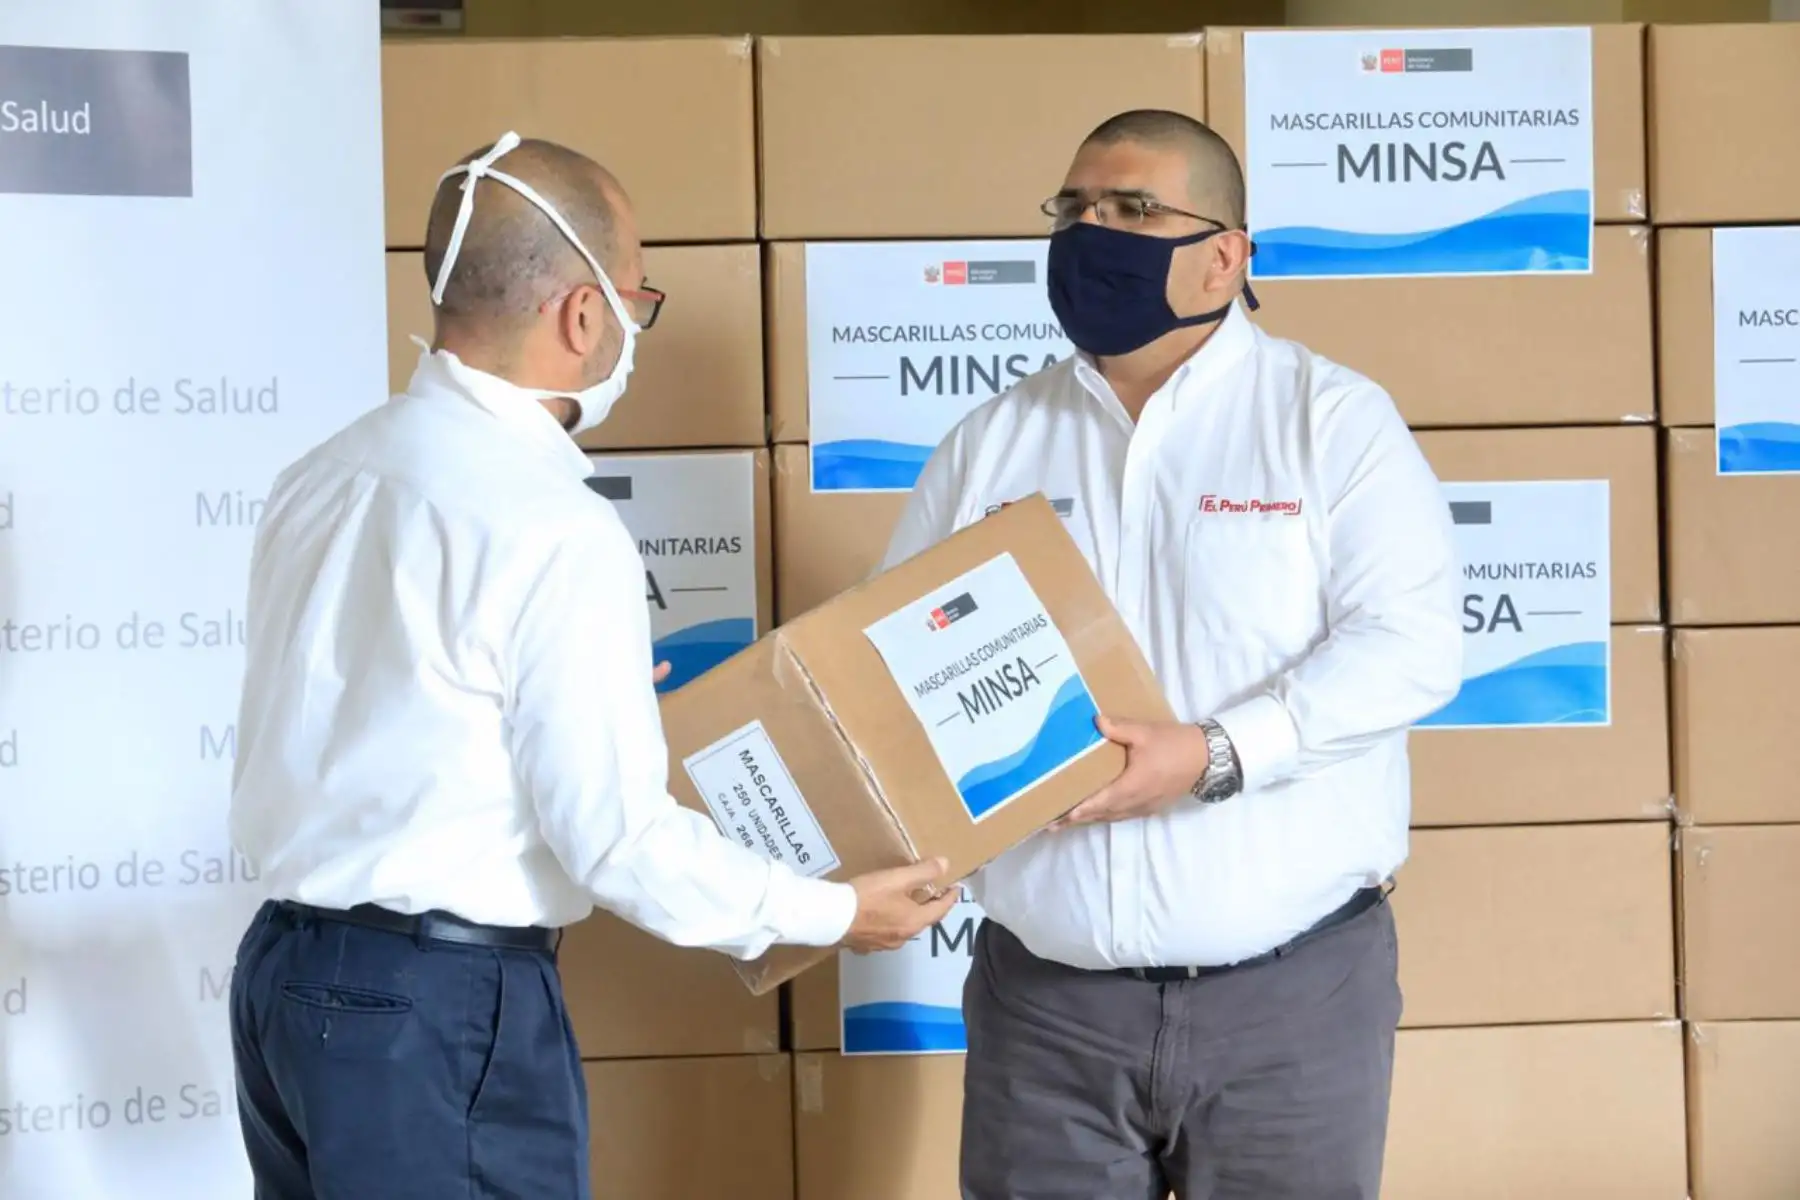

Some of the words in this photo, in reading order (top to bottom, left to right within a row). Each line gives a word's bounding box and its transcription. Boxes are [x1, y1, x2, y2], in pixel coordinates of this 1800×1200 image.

[1, 100, 90, 135] Salud
[1270, 112, 1414, 131] MASCARILLAS
[1418, 109, 1580, 129] COMUNITARIAS
[1336, 141, 1506, 184] MINSA
[832, 325, 977, 343] MASCARILLAS
[114, 377, 161, 415] de
[174, 377, 280, 415] Salud
[1462, 562, 1597, 580] MUNITARIAS
[116, 611, 166, 650] de
[914, 653, 980, 697] MASCARILLAS
[977, 613, 1044, 662] COMUNITARIAS
[957, 656, 1041, 724] MINSA
[733, 783, 751, 807] 250
[748, 808, 783, 861] UNIDADES
[738, 749, 811, 865] MASCARILLAS
[115, 850, 165, 888] de
[124, 1086, 166, 1125] de
